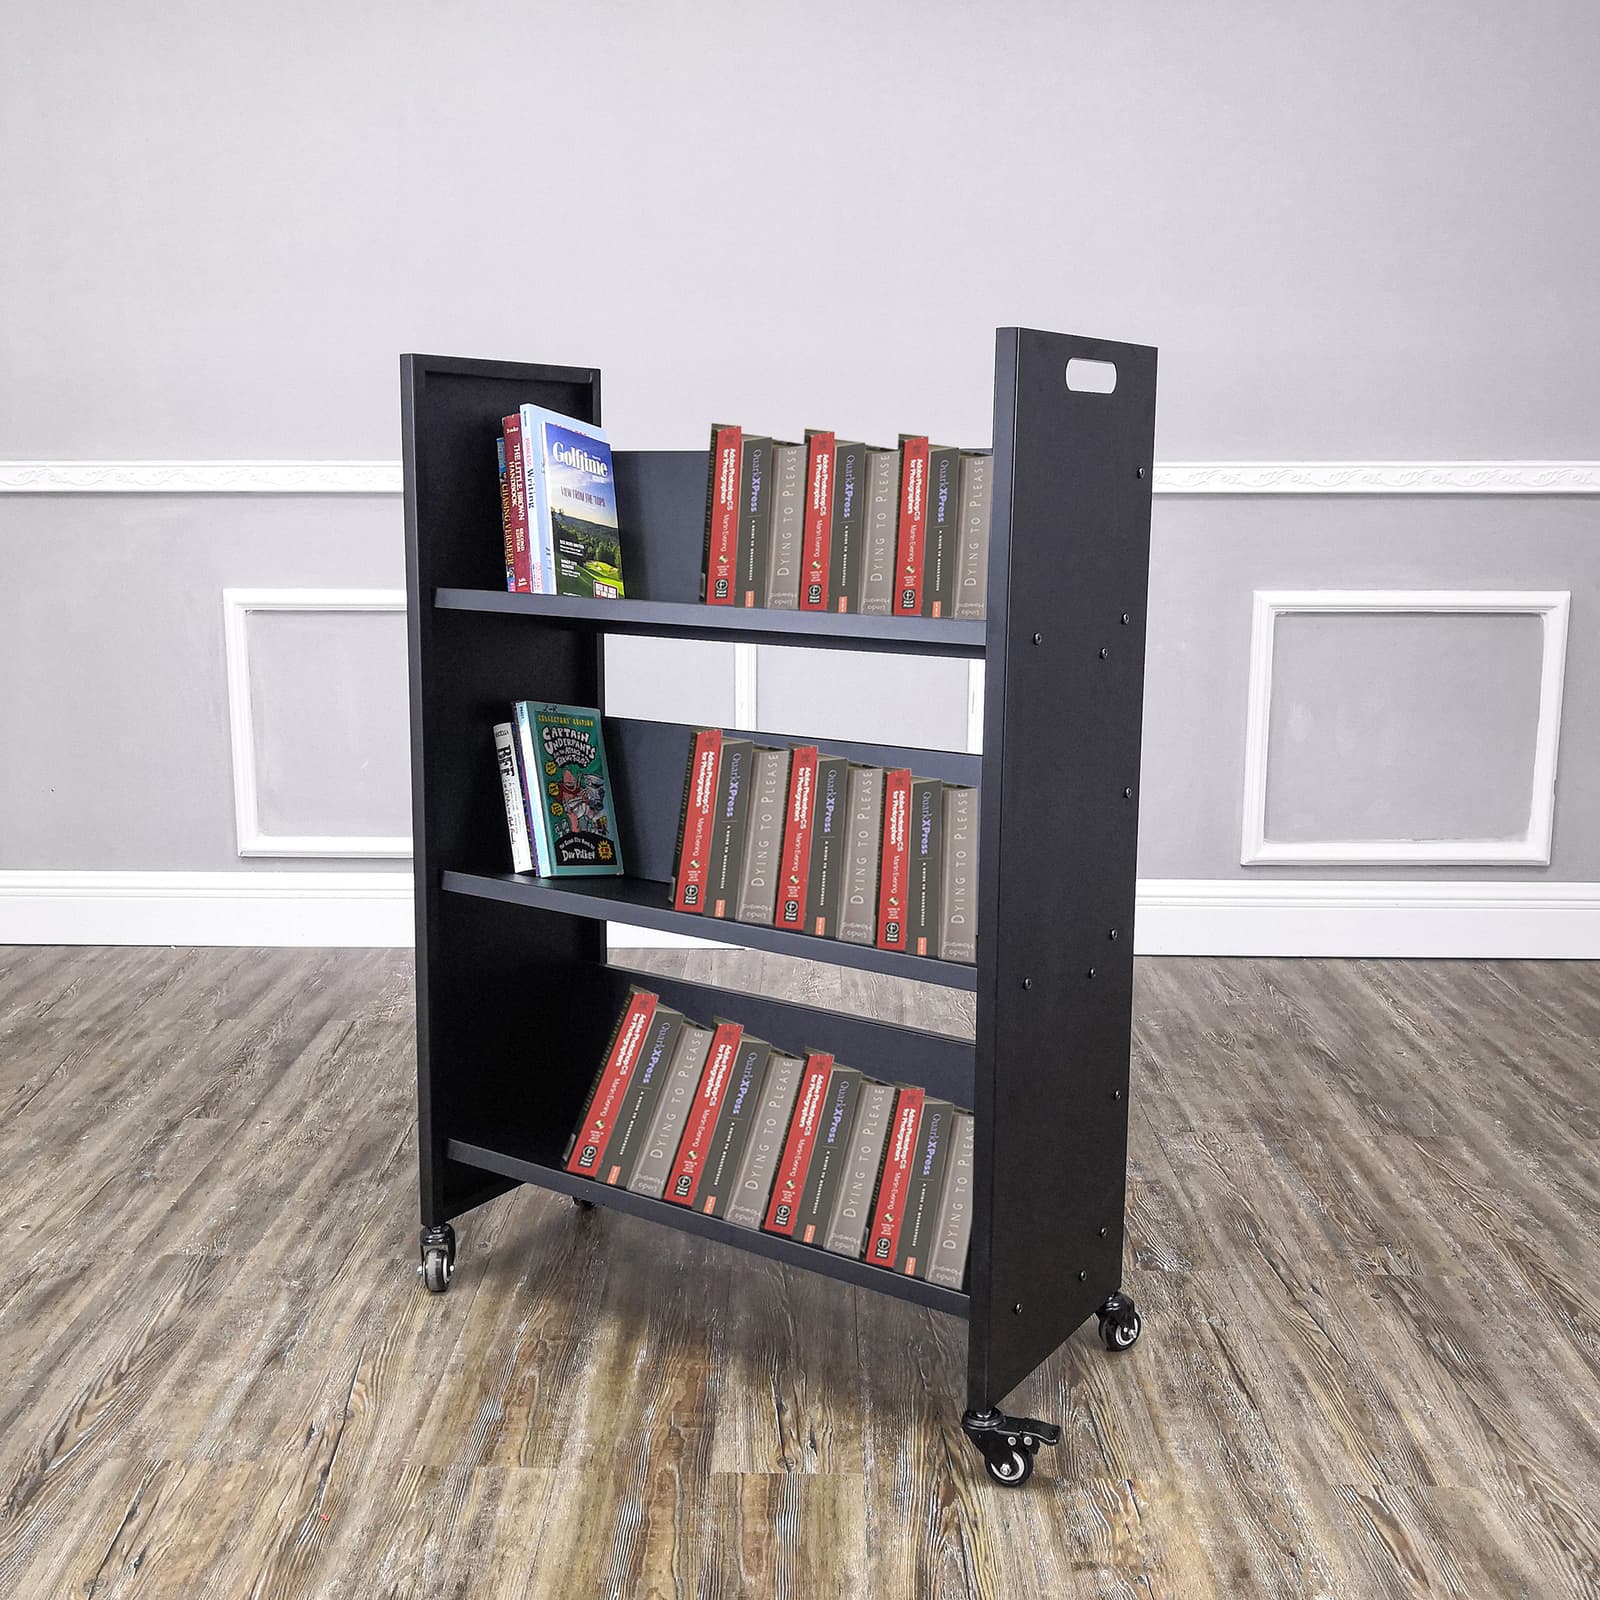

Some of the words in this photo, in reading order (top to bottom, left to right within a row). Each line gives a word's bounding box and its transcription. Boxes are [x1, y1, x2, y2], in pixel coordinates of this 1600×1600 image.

[552, 442, 608, 478] Golftime
[720, 458, 728, 503] Photographers
[750, 448, 761, 512] QuarkXPress
[782, 449, 796, 496] PLEASE
[875, 454, 889, 501] PLEASE
[502, 484, 511, 521] CHASING
[509, 462, 518, 507] HANDBOOK
[527, 468, 536, 508] Writing
[572, 488, 584, 502] FROM
[584, 492, 593, 504] THE
[726, 468, 734, 500] Photoshop
[813, 464, 821, 509] Photographers
[819, 474, 827, 505] Photoshop
[843, 454, 855, 517] QuarkXPress
[907, 468, 915, 514] Photographers
[913, 479, 921, 510] Photoshop
[937, 459, 949, 522] QuarkXPress
[969, 459, 983, 506] PLEASE
[783, 507, 793, 523] TO
[876, 513, 886, 528] TO
[970, 517, 980, 533] TO
[505, 522, 514, 566] VERMEER
[776, 532, 791, 576] DYING
[869, 538, 884, 581] DYING
[963, 542, 978, 586] DYING
[702, 771, 712, 803] Photoshop
[726, 752, 741, 817] QuarkXPress
[760, 754, 777, 802] PLEASE
[857, 771, 872, 819] PLEASE
[760, 814, 772, 830] TO
[800, 787, 809, 818] Photoshop
[824, 769, 836, 832] QuarkXPress
[921, 790, 932, 854] QuarkXPress
[953, 792, 966, 839] PLEASE
[857, 830, 869, 846] TO
[896, 810, 904, 841] Photoshop
[750, 840, 769, 887] DYING
[850, 856, 866, 905] DYING
[955, 850, 966, 867] TO
[950, 877, 965, 924] DYING
